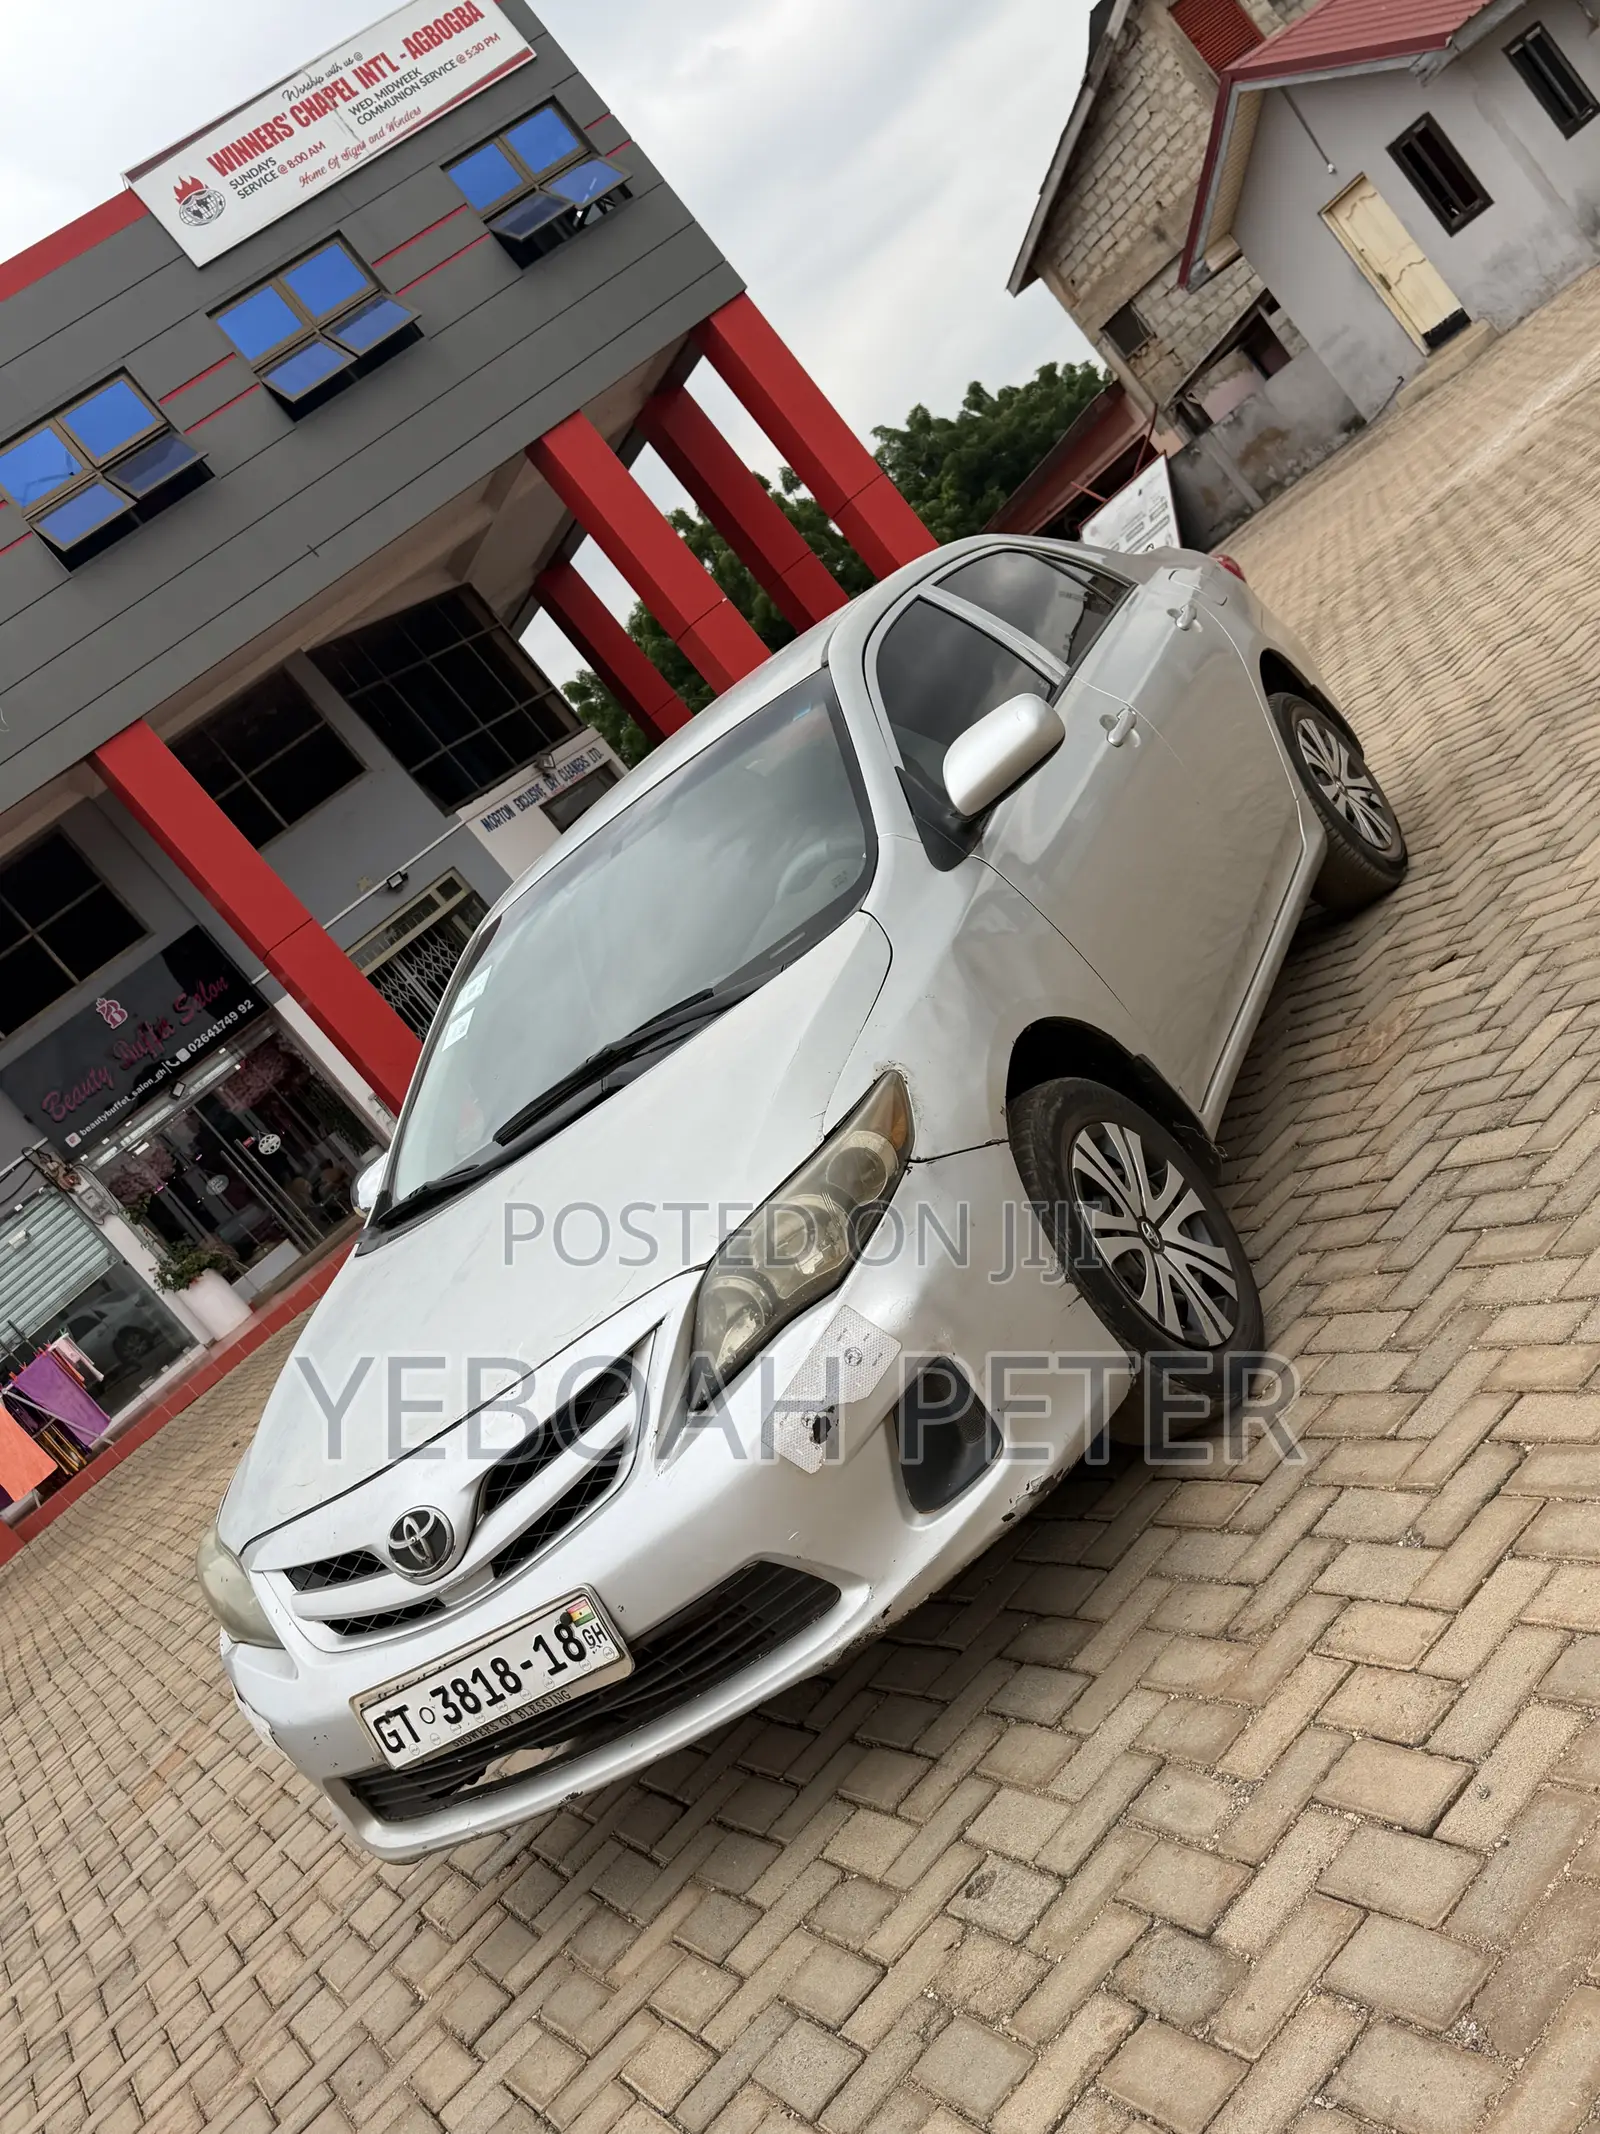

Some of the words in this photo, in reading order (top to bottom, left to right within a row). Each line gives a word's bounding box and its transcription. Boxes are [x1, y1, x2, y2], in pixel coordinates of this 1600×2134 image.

[206, 112, 294, 177] WINNERS'
[290, 77, 360, 128] CHAPEL
[402, 0, 485, 60] AGBOGBA
[282, 73, 324, 101] Worship
[325, 62, 343, 78] with
[343, 57, 354, 67] us
[348, 97, 377, 116] WED.
[374, 67, 422, 101] MIDWEEK
[357, 82, 421, 125] COMMUNION
[419, 59, 458, 87] SERVICE
[456, 54, 467, 64] @
[465, 42, 486, 59] 5:30
[483, 32, 501, 48] PM
[229, 157, 277, 189] SUNDAYS
[237, 170, 279, 199] SERVICE
[277, 164, 288, 174] @
[286, 152, 308, 169] 8:00
[308, 141, 326, 157] AM
[299, 166, 327, 187] Home
[328, 155, 341, 169] Of
[341, 139, 366, 160] Signs
[368, 127, 386, 145] and
[385, 106, 422, 132] Wonders
[480, 804, 516, 832] MORTON
[42, 1066, 114, 1121] Beauty
[174, 976, 229, 1025] Salon
[187, 1011, 239, 1053] 02641749
[237, 999, 254, 1015] 92
[582, 1623, 608, 1648] GH
[373, 1704, 421, 1753] GT
[429, 1622, 587, 1725] 3818-18
[452, 1722, 499, 1748] SHOWERS
[500, 1715, 515, 1727] OF
[517, 1689, 572, 1719] BLESSING
